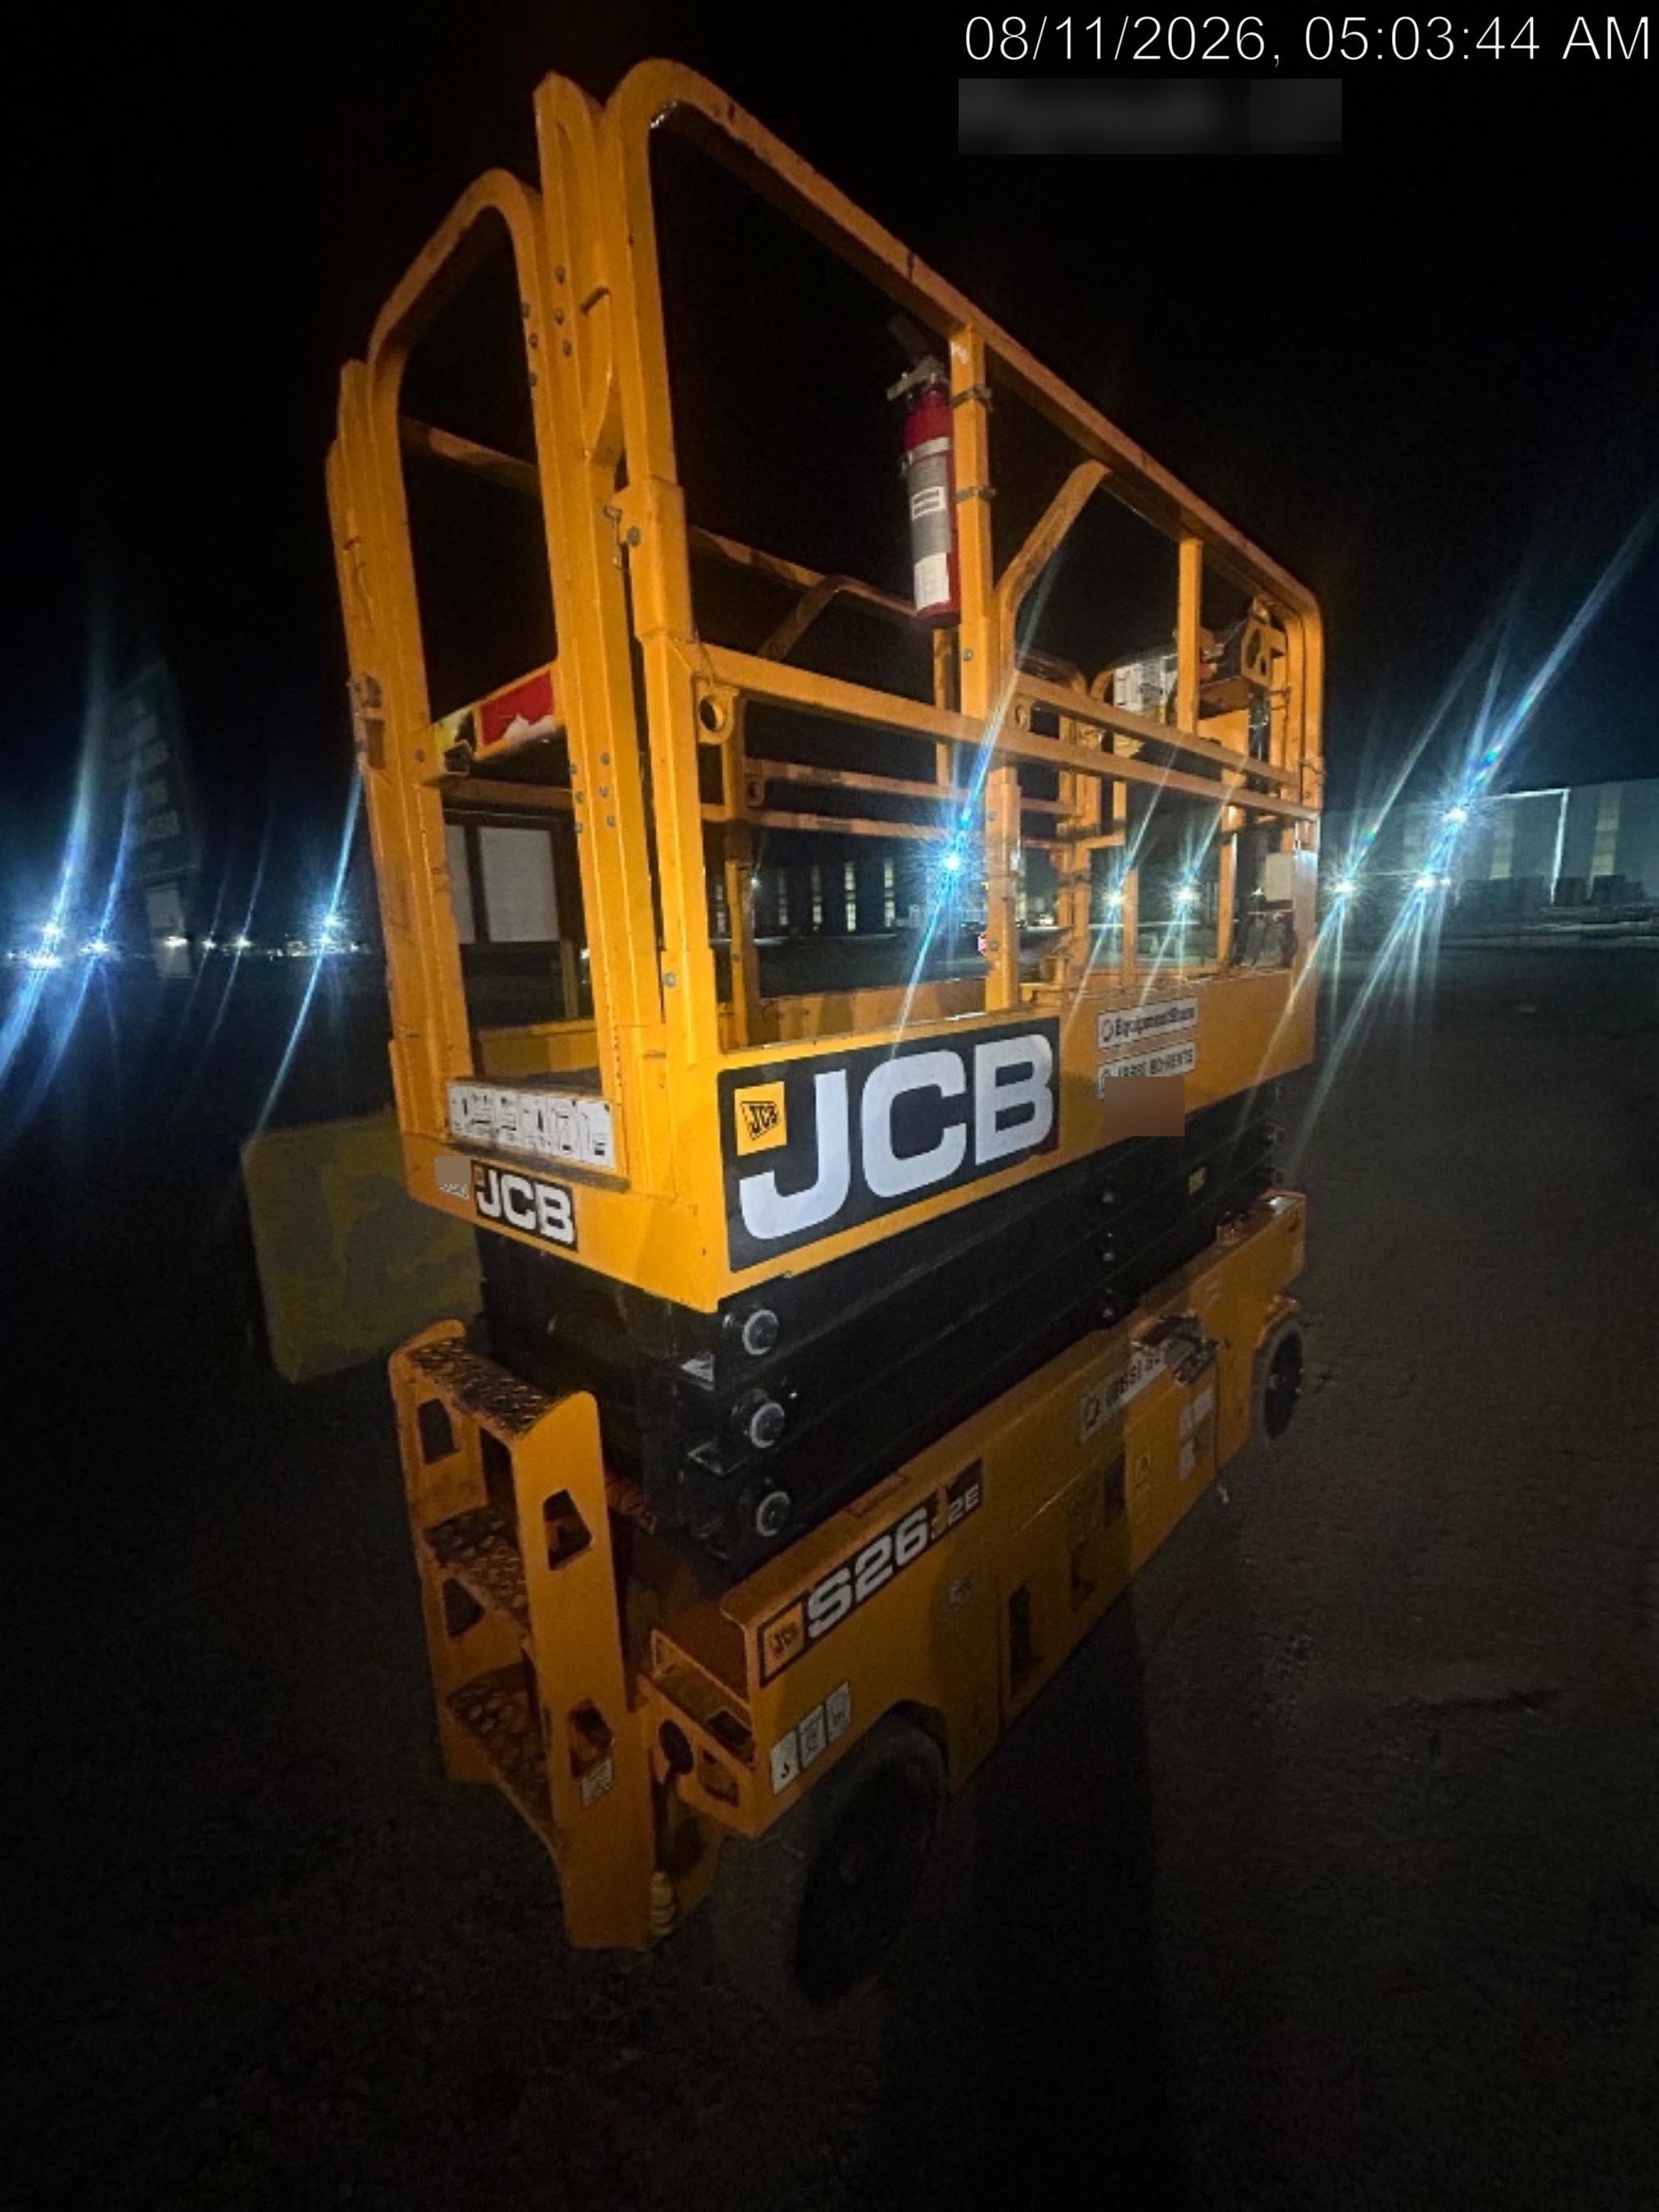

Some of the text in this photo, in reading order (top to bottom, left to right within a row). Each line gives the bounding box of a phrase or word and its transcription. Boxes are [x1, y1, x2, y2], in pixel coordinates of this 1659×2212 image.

[739, 1034, 1054, 1240] JCB
[750, 1105, 777, 1135] JCB
[476, 1169, 574, 1244] JCB
